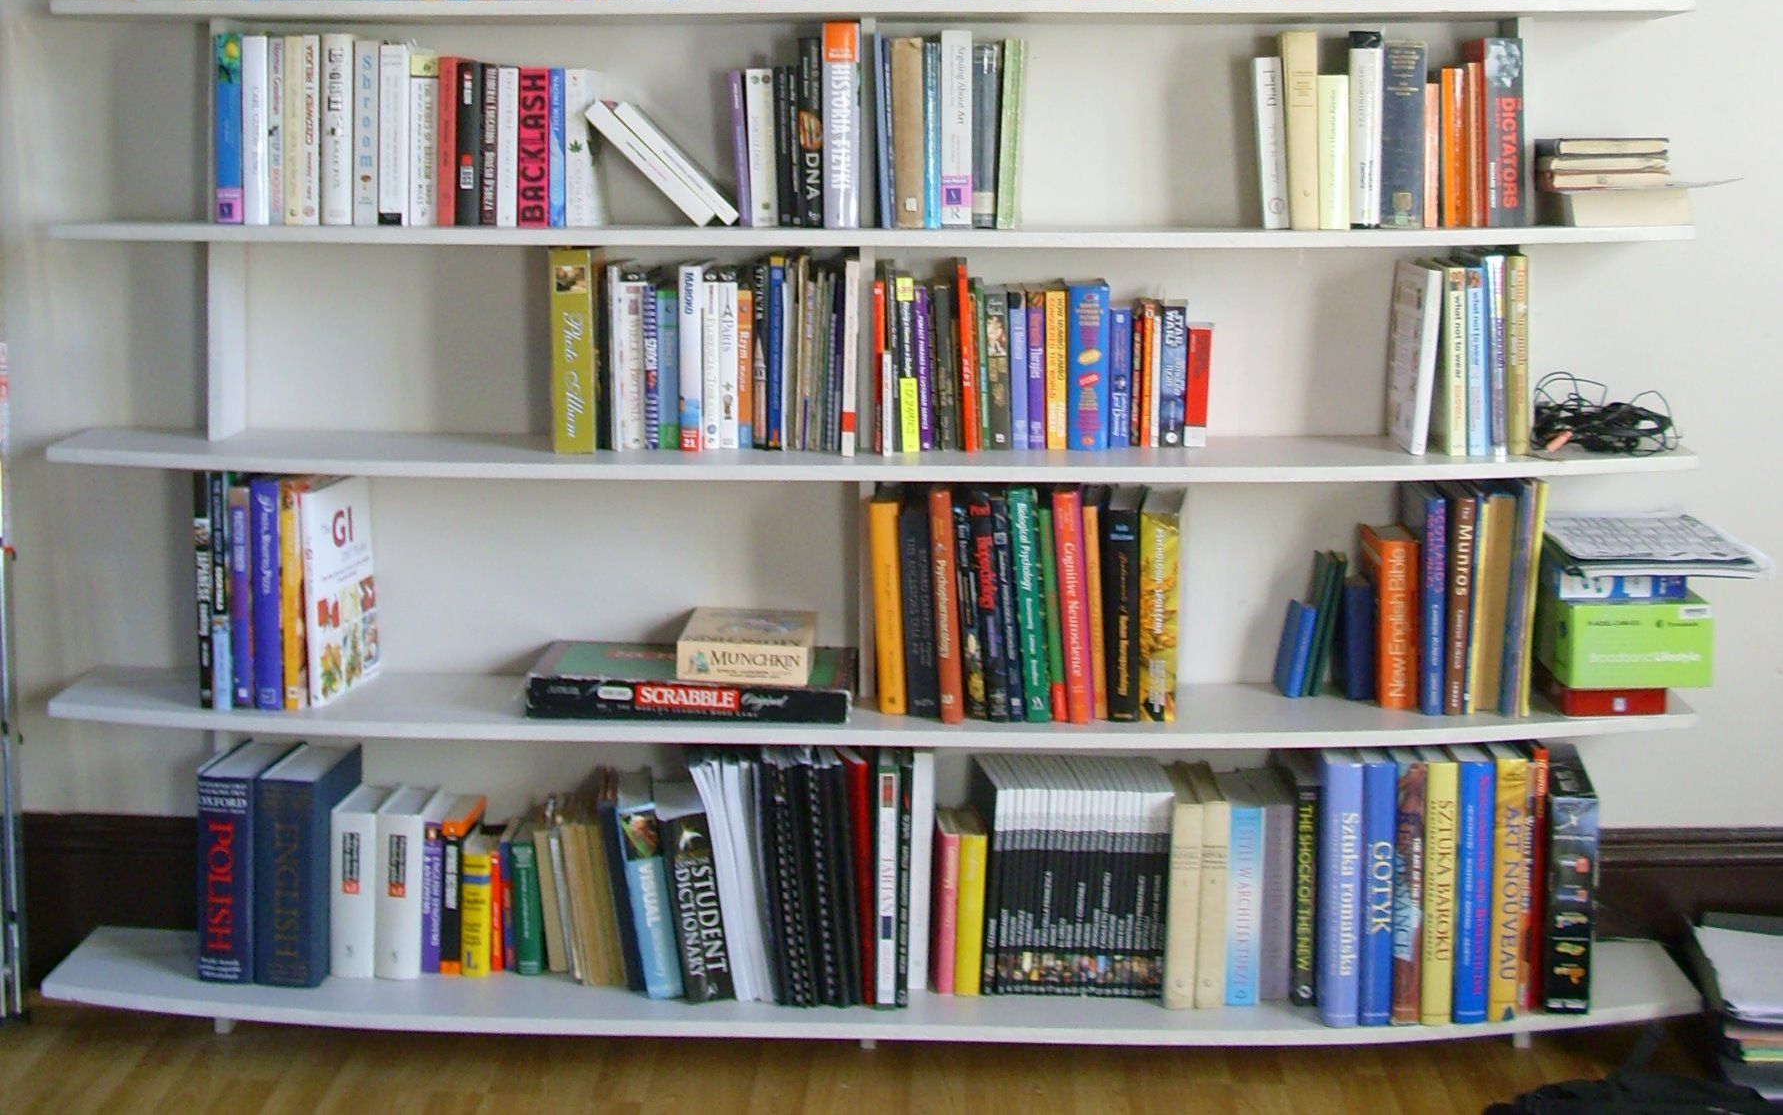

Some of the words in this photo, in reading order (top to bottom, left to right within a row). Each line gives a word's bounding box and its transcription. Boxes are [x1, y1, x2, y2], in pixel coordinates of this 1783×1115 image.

[955, 45, 967, 80] Arguing
[831, 64, 851, 135] HISTORIA
[957, 83, 966, 108] About
[957, 110, 966, 125] Art
[521, 74, 546, 222] BACKLASH
[831, 140, 851, 190] FIZYKI
[1501, 97, 1519, 209] DICTATORS
[805, 153, 819, 201] DNA
[684, 272, 695, 316] MAROKO
[1454, 295, 1462, 320] what
[1472, 291, 1480, 314] what
[562, 312, 584, 364] Photo
[1165, 310, 1176, 347] WARS
[1174, 314, 1184, 346] STAR
[1454, 322, 1462, 340] not
[564, 371, 586, 439] Album
[332, 506, 354, 548] GI
[1016, 503, 1030, 544] Biological
[976, 535, 997, 611] Biopsychology
[1020, 546, 1033, 592] Psychology
[1062, 542, 1077, 598] Cognitive
[1155, 529, 1164, 584] PSYCHOLOGIA
[1388, 548, 1407, 591] Bible
[1434, 507, 1446, 594] SCOTLAND'S
[1455, 525, 1473, 596] Munros
[196, 551, 211, 601] JAPANESE
[935, 559, 950, 659] Psychopharmacology
[1388, 594, 1407, 655] English
[710, 650, 801, 670] MUNCHKIN
[1067, 600, 1083, 677] Neuroscience
[639, 686, 735, 707] SCRABBLE
[1388, 656, 1407, 698] New
[1297, 805, 1313, 832] THE
[1436, 800, 1454, 878] SZTUKA
[1504, 804, 1522, 854] ART
[1238, 829, 1254, 862] STYLE
[1297, 834, 1313, 885] SHOCK
[1341, 812, 1360, 876] Sztuka
[1412, 838, 1421, 850] THE
[1412, 852, 1421, 869] ART
[207, 820, 235, 952] POLISH
[274, 823, 300, 957] ENGLISH
[638, 862, 660, 928] VISUAL
[881, 857, 895, 913] TARTAN
[1238, 867, 1252, 879] W
[1297, 887, 1313, 903] OF
[1371, 841, 1394, 935] GOTYK
[1394, 812, 1415, 956] RENAISSANCE
[1412, 871, 1420, 879] OF
[1412, 882, 1420, 893] THE
[1477, 877, 1487, 903] AND
[674, 868, 706, 978] DICTIONARY
[692, 865, 728, 973] STUDENT
[1234, 882, 1252, 984] ARCHITEKTURZE
[1297, 908, 1312, 934] THE
[1340, 883, 1358, 976] romańska
[1435, 883, 1453, 963] BAROKU
[1499, 861, 1521, 981] NOUVEAU
[1296, 936, 1312, 971] NEW
[1472, 908, 1486, 996] ROMANTICISM
